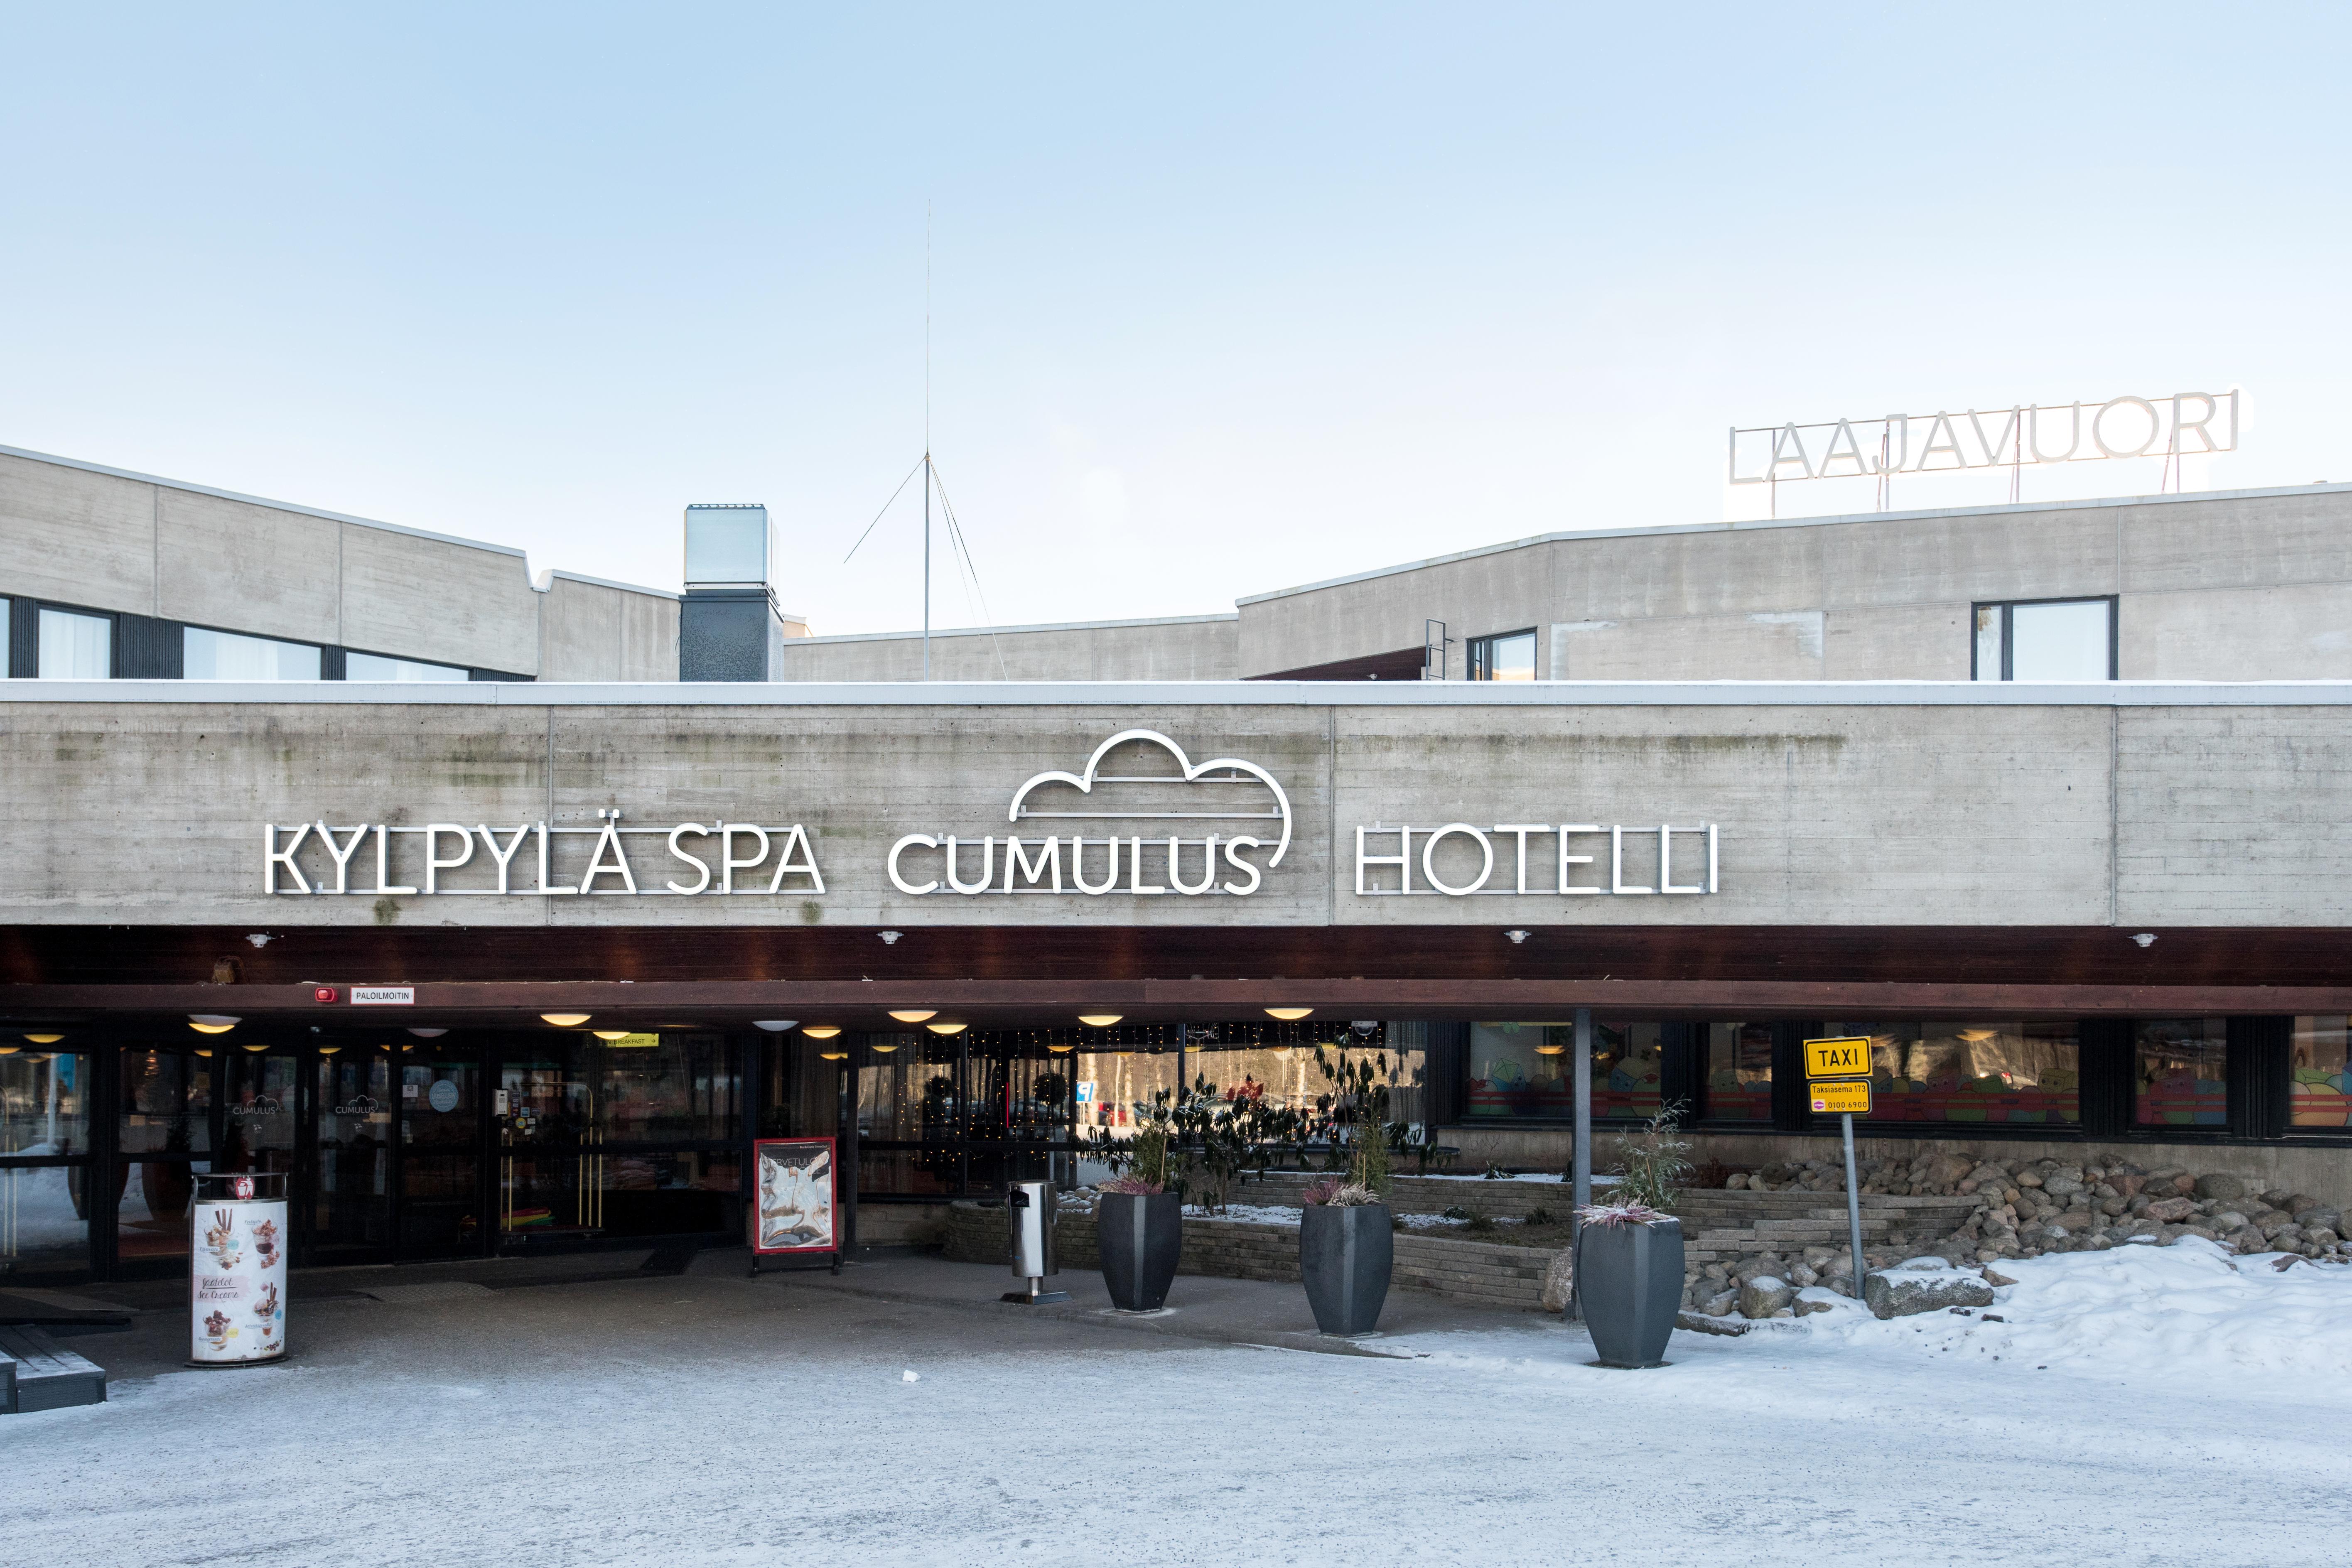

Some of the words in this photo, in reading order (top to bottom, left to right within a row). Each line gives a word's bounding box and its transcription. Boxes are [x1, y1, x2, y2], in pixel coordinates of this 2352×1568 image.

[1729, 389, 2238, 485] LAAJAVUORI
[265, 808, 637, 895] KYLPYLÄ
[667, 822, 826, 895] SPA
[887, 834, 1262, 896] CUMULUS
[1355, 822, 1718, 896] HOTELLI
[1818, 1048, 1858, 1067] TAXI
[233, 1107, 275, 1115] CUMULUS
[211, 1291, 240, 1299] Creams
